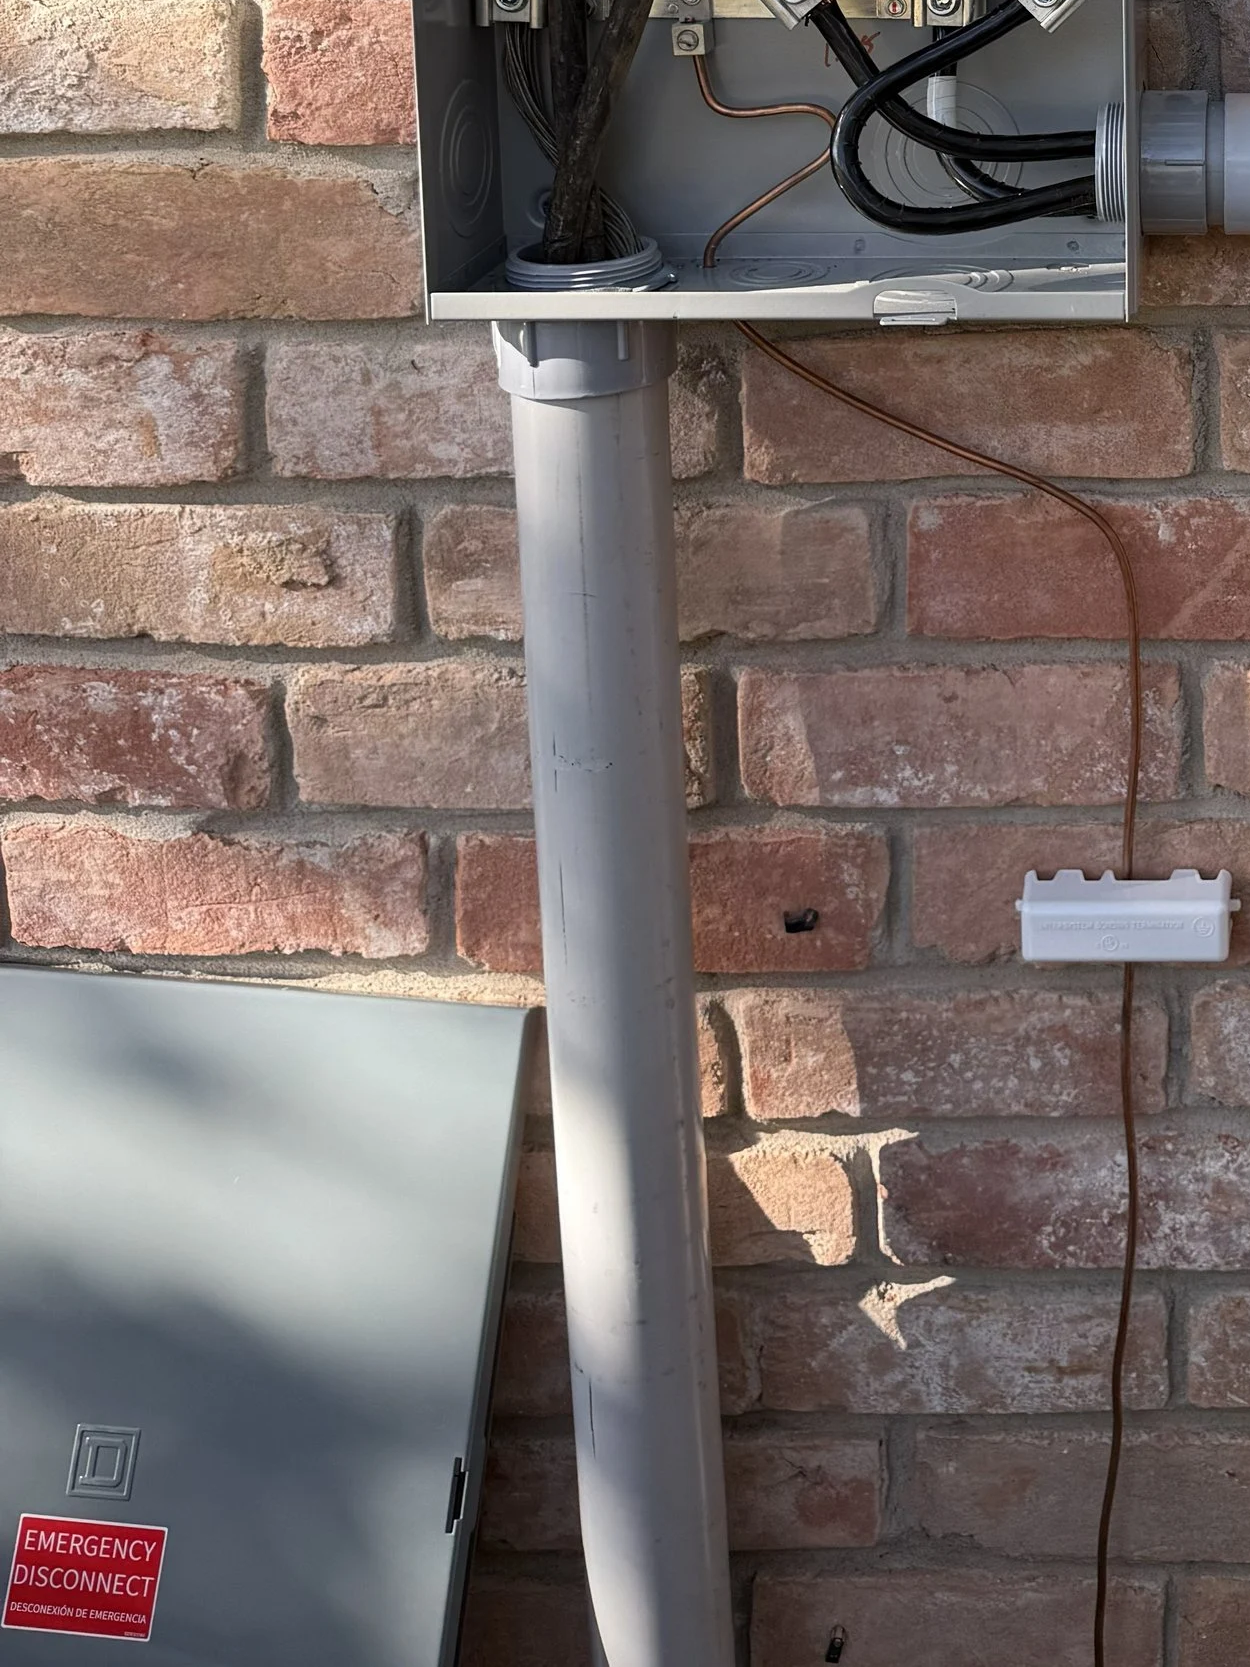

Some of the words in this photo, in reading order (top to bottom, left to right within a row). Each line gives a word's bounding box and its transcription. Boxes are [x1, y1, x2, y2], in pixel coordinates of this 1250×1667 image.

[24, 1529, 157, 1562] EMERGENCY
[13, 1564, 155, 1598] DISCONNECT
[10, 1601, 74, 1617] DESCONEXIÓN
[76, 1608, 88, 1619] DE
[89, 1610, 147, 1624] EMERGENCIA
